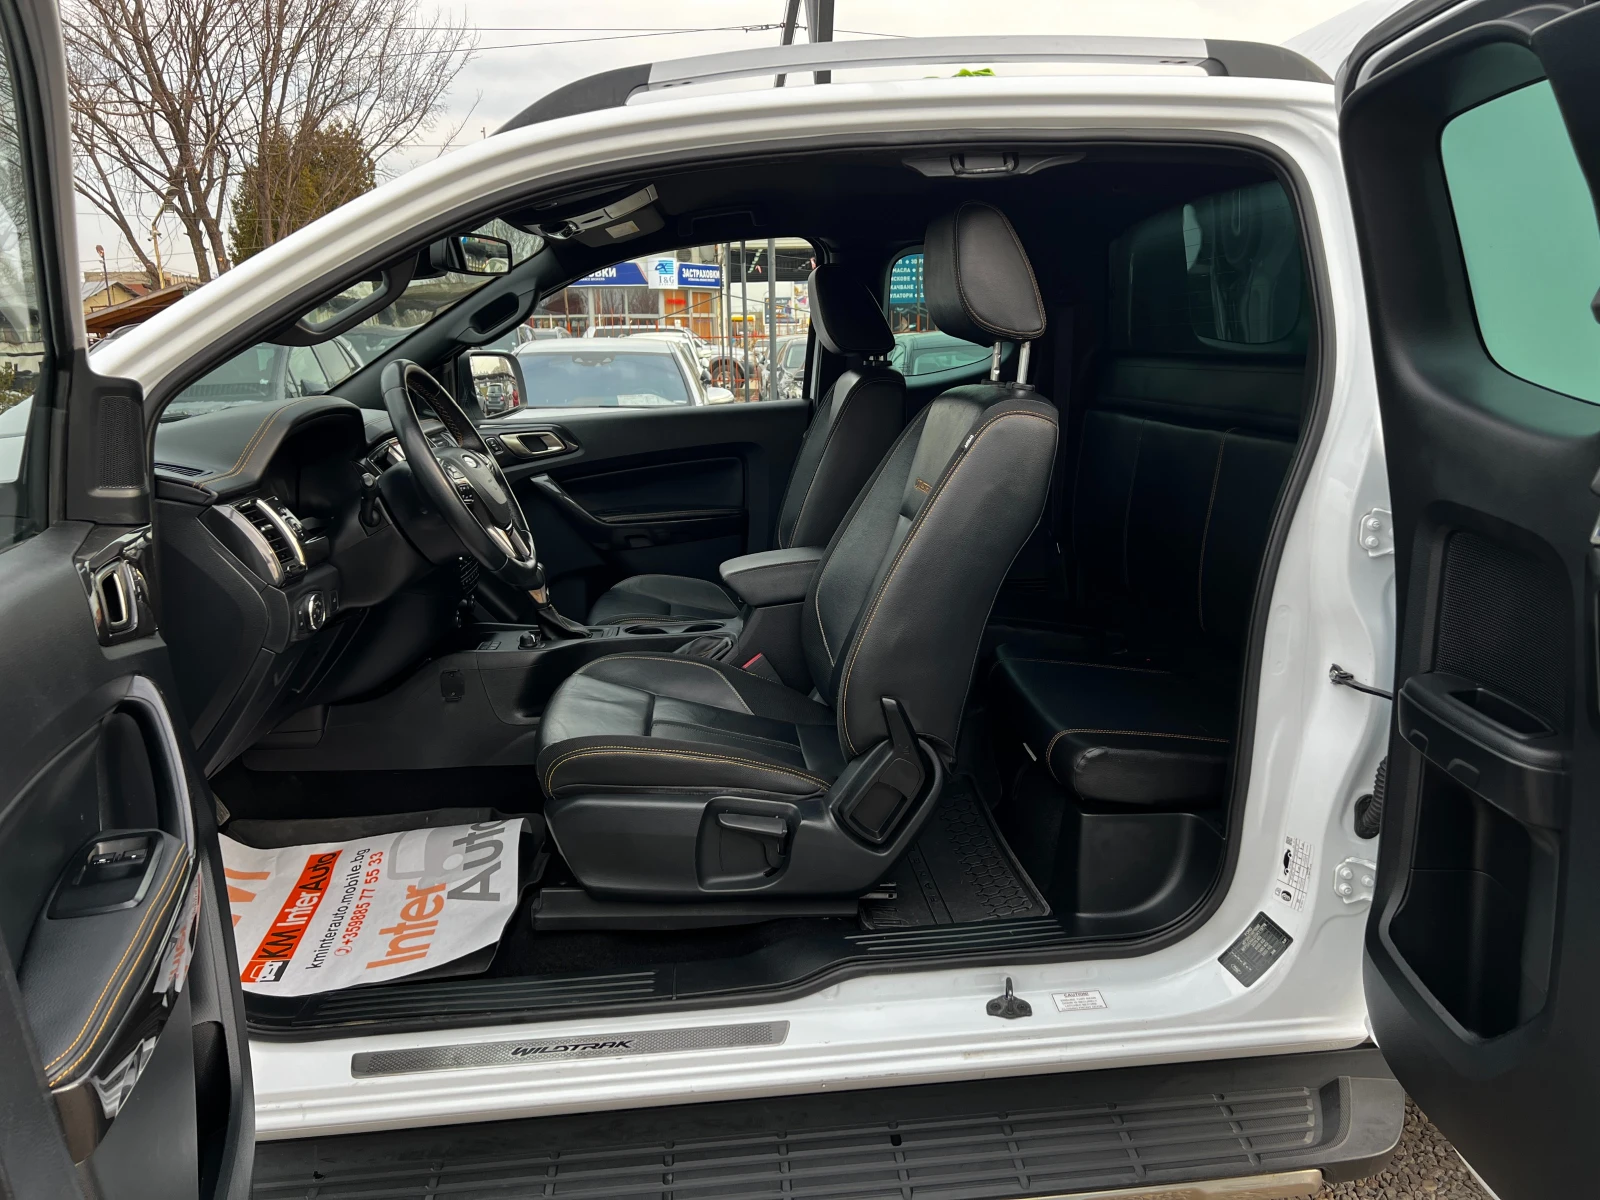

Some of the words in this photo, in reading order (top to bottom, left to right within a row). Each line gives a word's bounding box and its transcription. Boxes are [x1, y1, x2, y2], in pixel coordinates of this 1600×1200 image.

[682, 268, 720, 279] ЗАСТРАХОВКИ
[368, 851, 384, 867] 33
[364, 868, 380, 885] 55
[359, 888, 376, 901] 77
[305, 848, 370, 970] kminterauto.mobile.bg
[366, 882, 447, 969] Inter
[257, 928, 302, 959] KM
[511, 1040, 634, 1057] WILDTRAK
